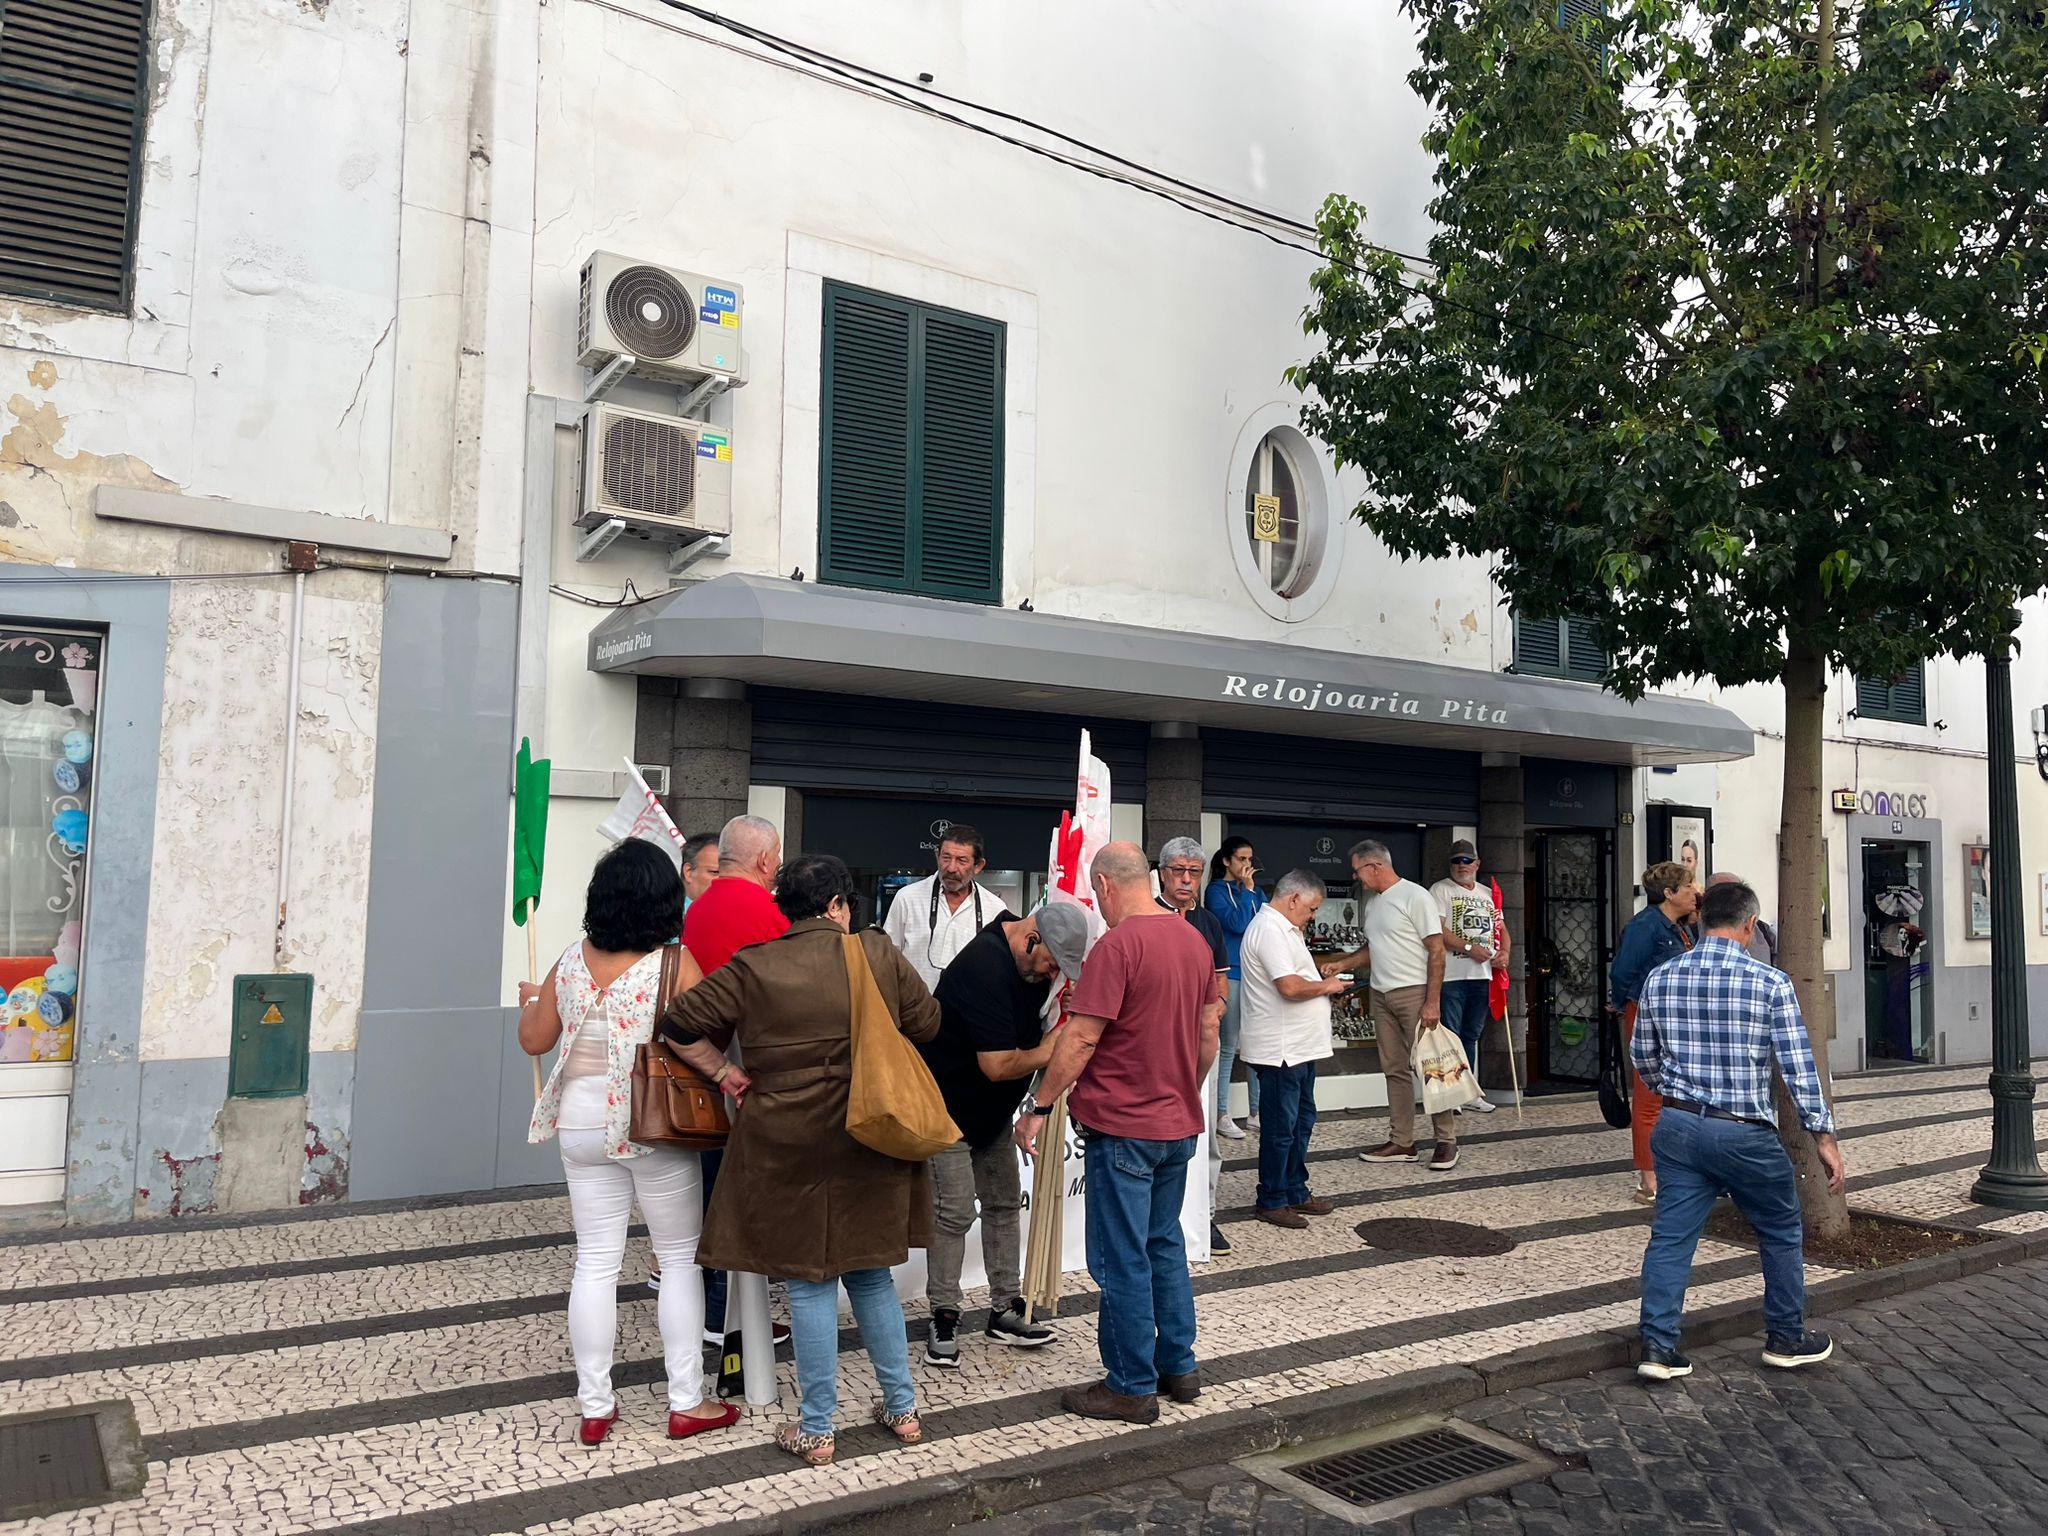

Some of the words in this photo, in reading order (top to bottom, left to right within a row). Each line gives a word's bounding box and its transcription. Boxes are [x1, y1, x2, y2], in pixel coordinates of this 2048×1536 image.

[707, 292, 734, 306] HTW
[596, 635, 634, 662] Relojoaria
[635, 631, 652, 651] Pita
[1221, 675, 1420, 712] Relojoaria
[1439, 699, 1509, 724] Pita
[1464, 916, 1490, 929] 305
